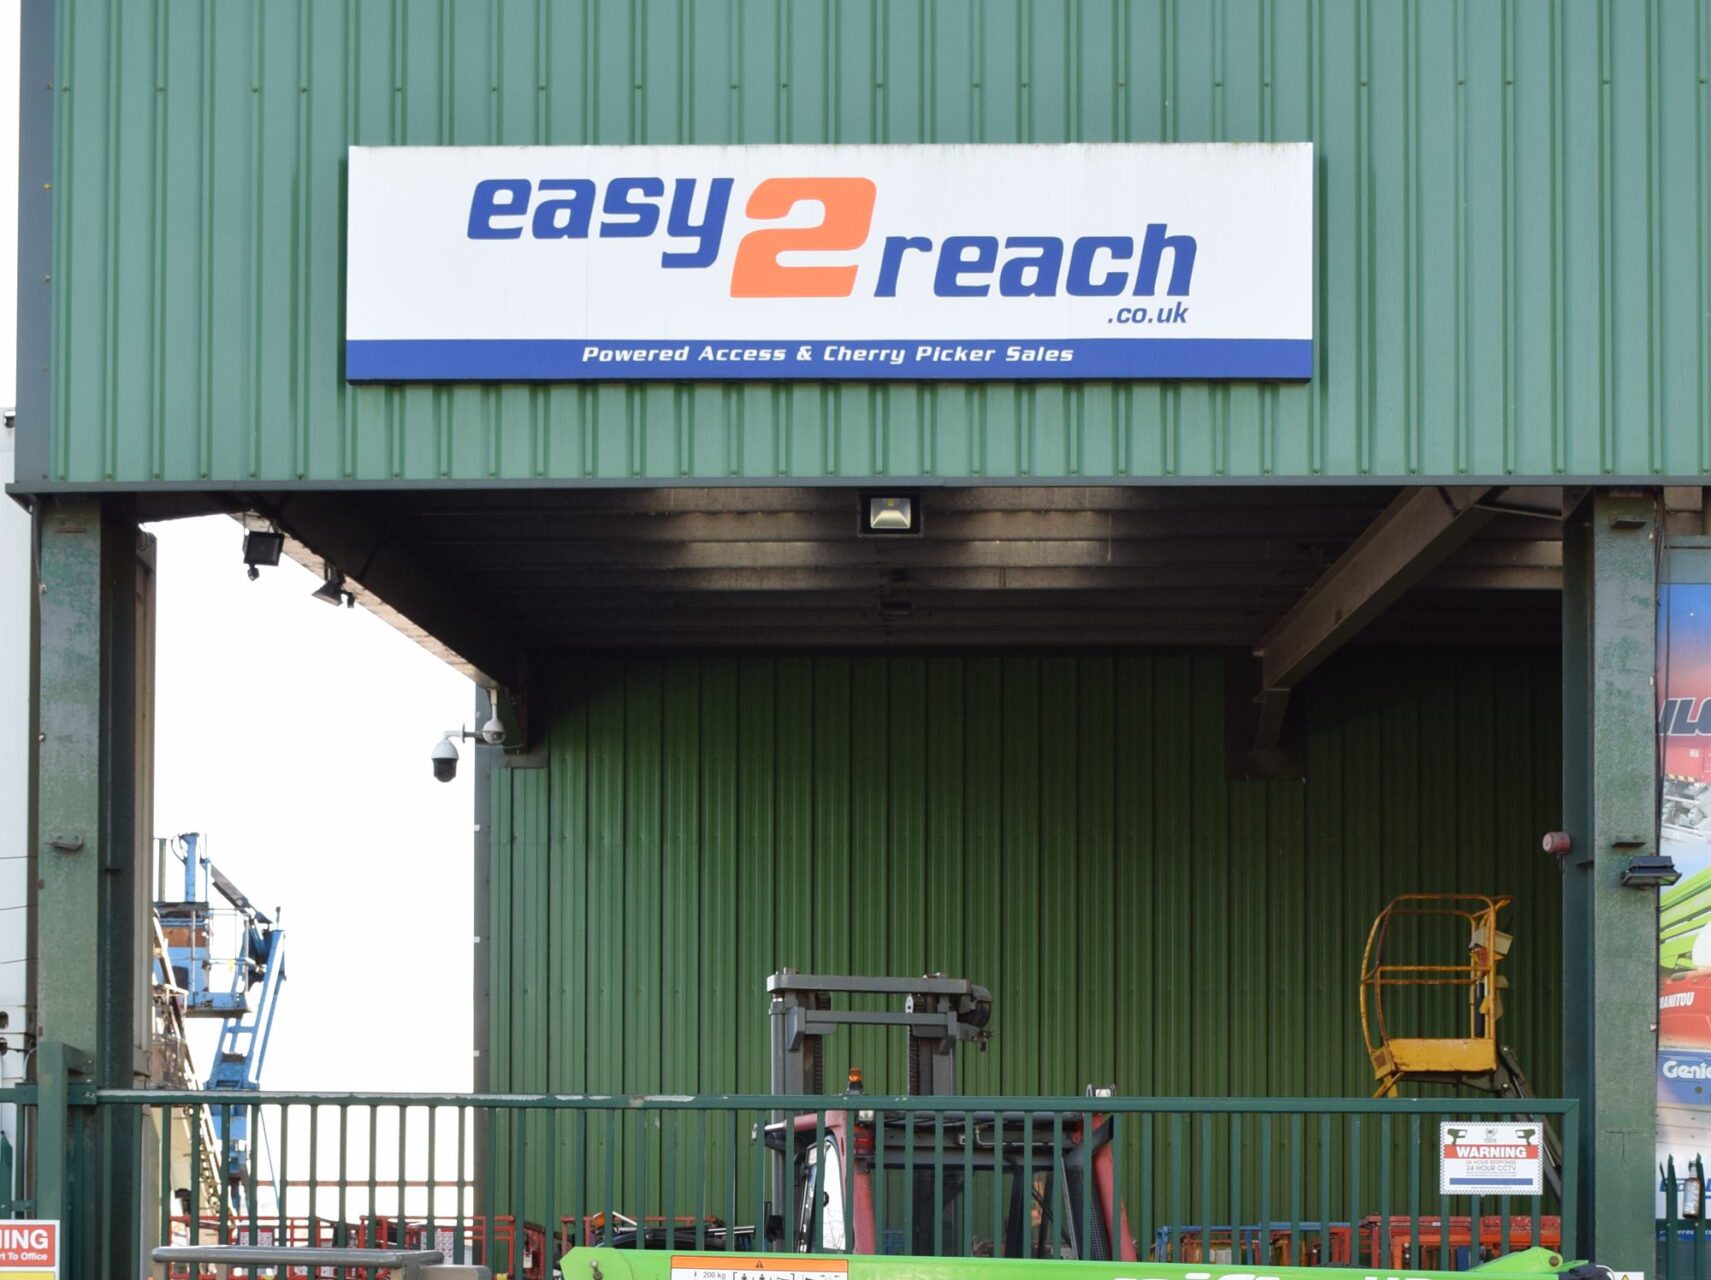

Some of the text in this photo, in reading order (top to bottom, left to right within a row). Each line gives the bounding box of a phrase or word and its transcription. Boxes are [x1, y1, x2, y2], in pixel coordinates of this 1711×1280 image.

[1107, 301, 1189, 324] .co.uk
[582, 345, 1074, 366] Powered Access & Cherry Picker Sales
[1456, 1147, 1527, 1158] WARNING
[0, 1229, 49, 1250] ING
[8, 1252, 19, 1261] To
[20, 1252, 48, 1261] Office
[717, 1271, 727, 1280] kg
